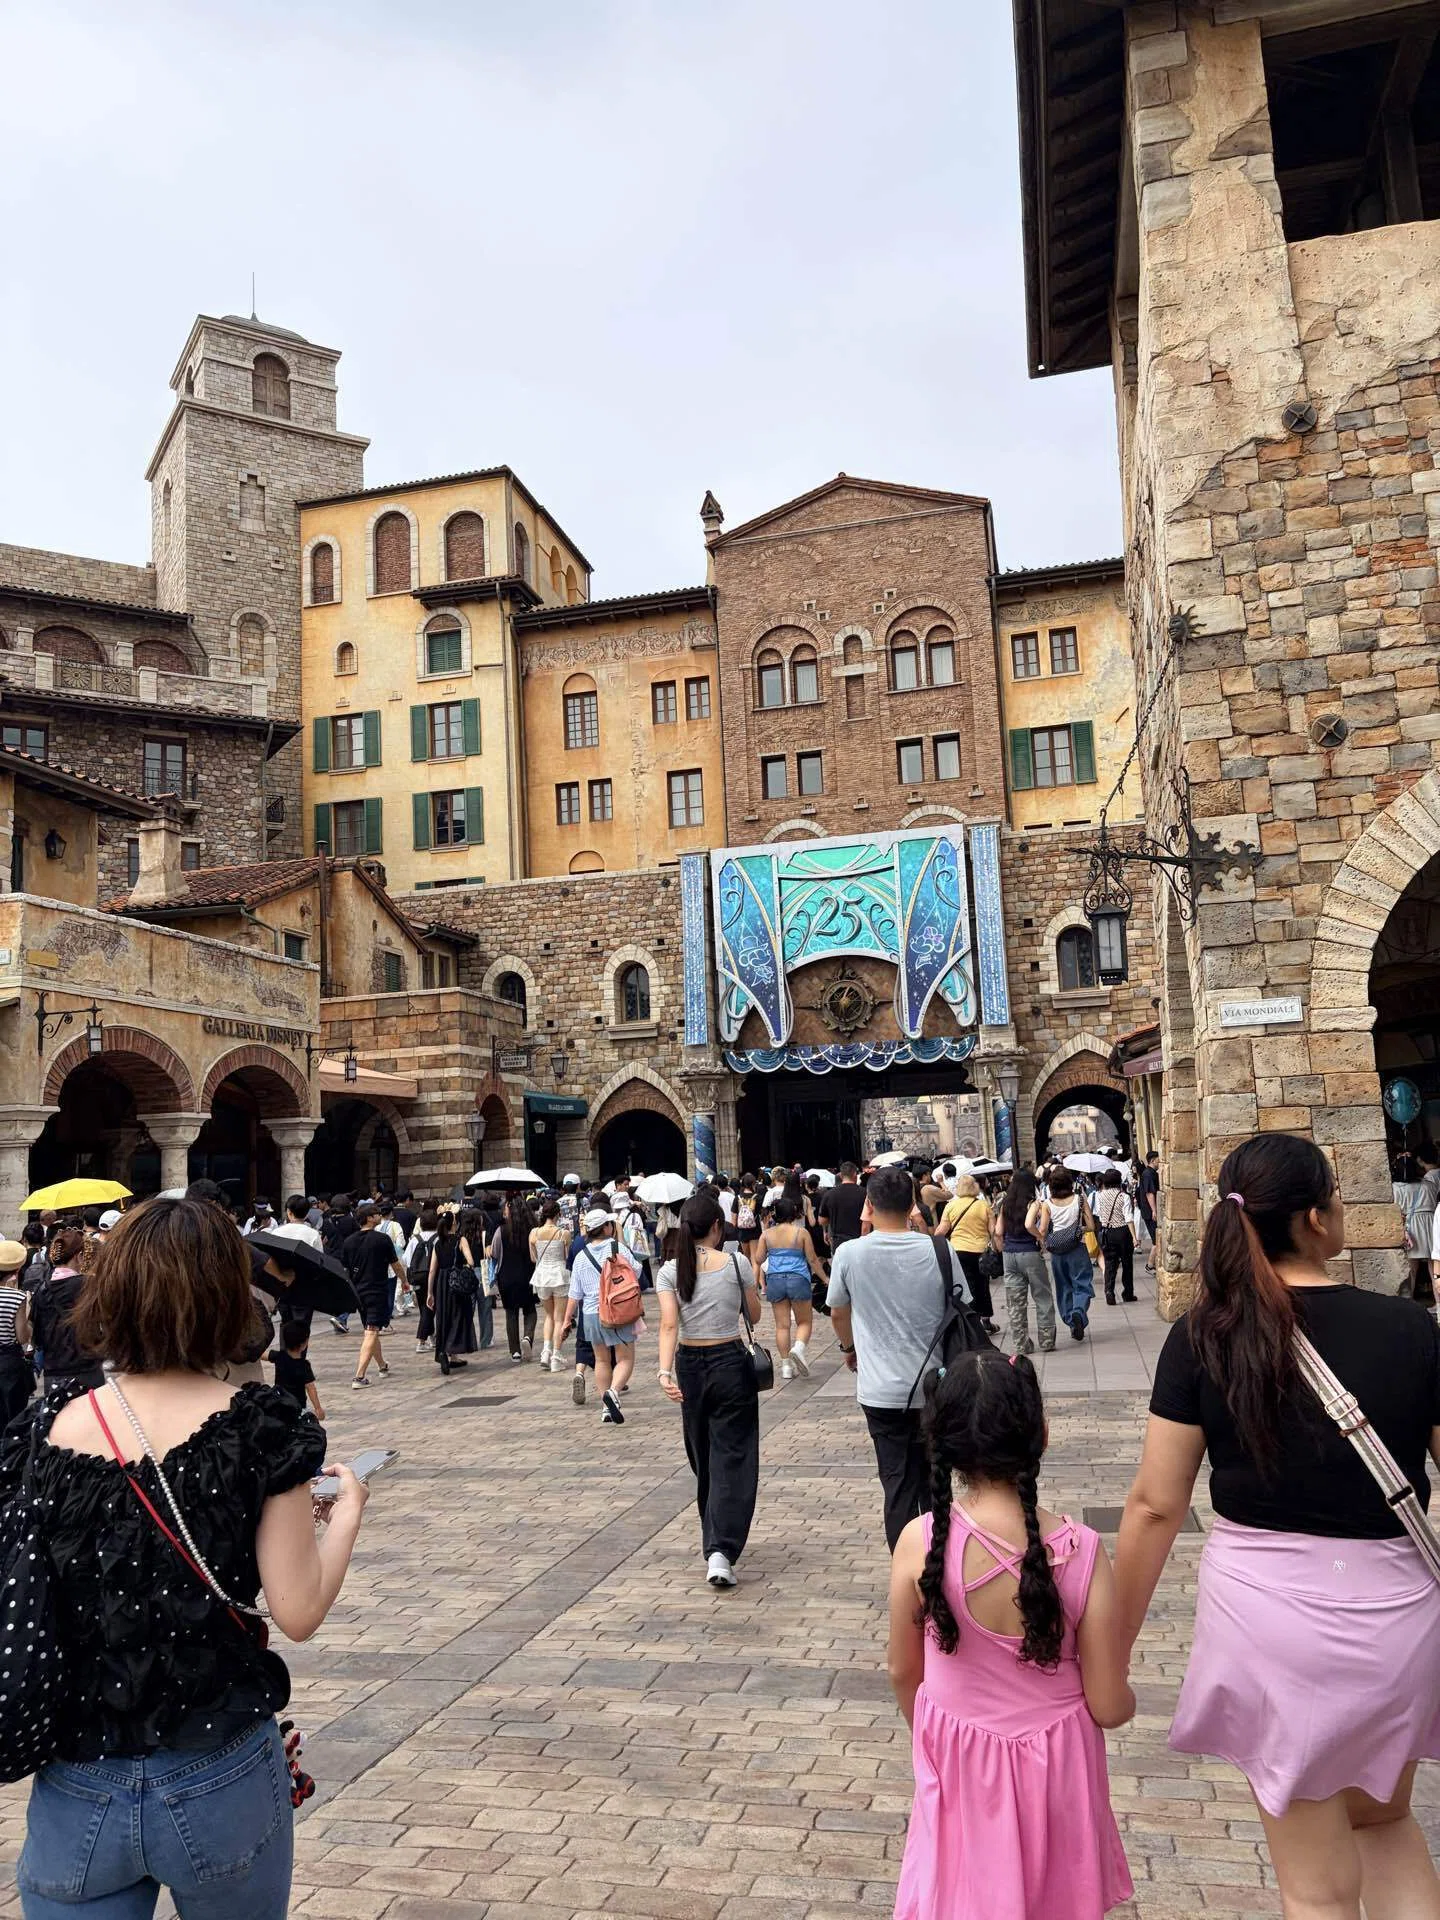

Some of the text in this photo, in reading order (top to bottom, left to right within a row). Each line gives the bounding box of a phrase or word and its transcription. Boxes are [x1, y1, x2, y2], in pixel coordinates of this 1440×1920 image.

[814, 892, 865, 946] 25
[1224, 1005, 1297, 1017] VIA MONDIALE
[202, 1017, 304, 1047] GALLERIA DISNEY
